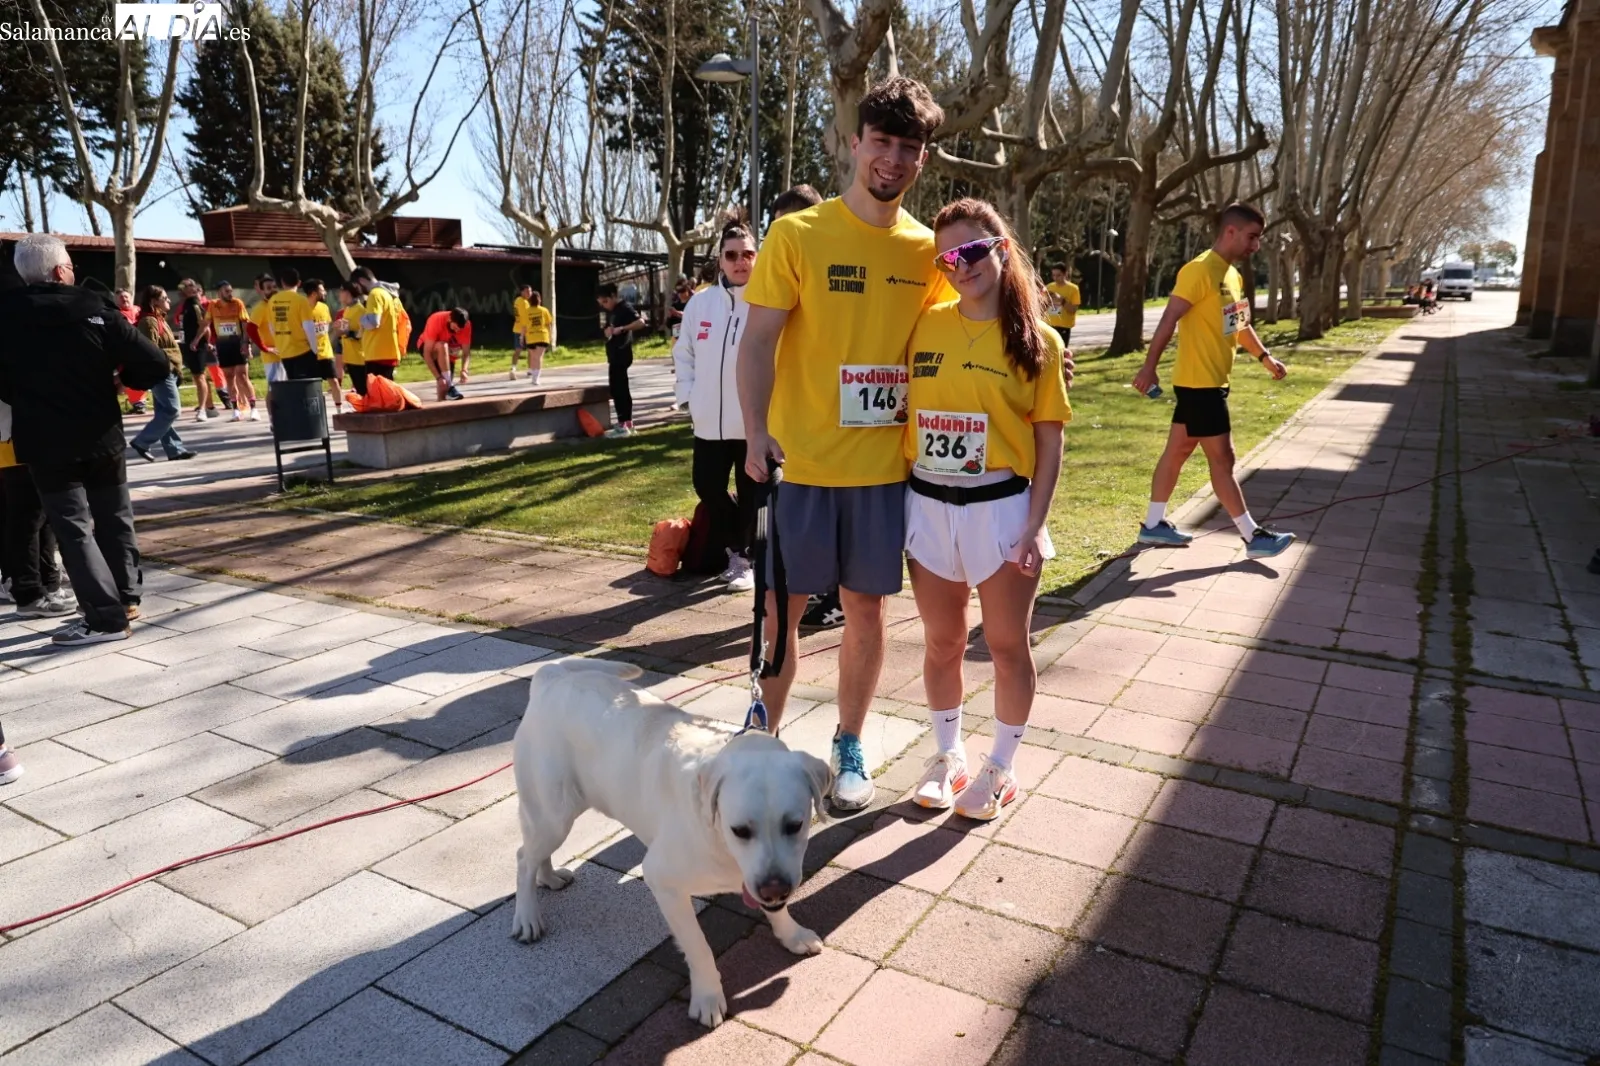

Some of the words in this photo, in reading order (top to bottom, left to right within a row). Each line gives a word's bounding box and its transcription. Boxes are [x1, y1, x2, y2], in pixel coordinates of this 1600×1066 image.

[859, 266, 867, 279] EL
[859, 386, 897, 411] 146
[917, 412, 986, 433] bedunia
[925, 432, 967, 459] 236
